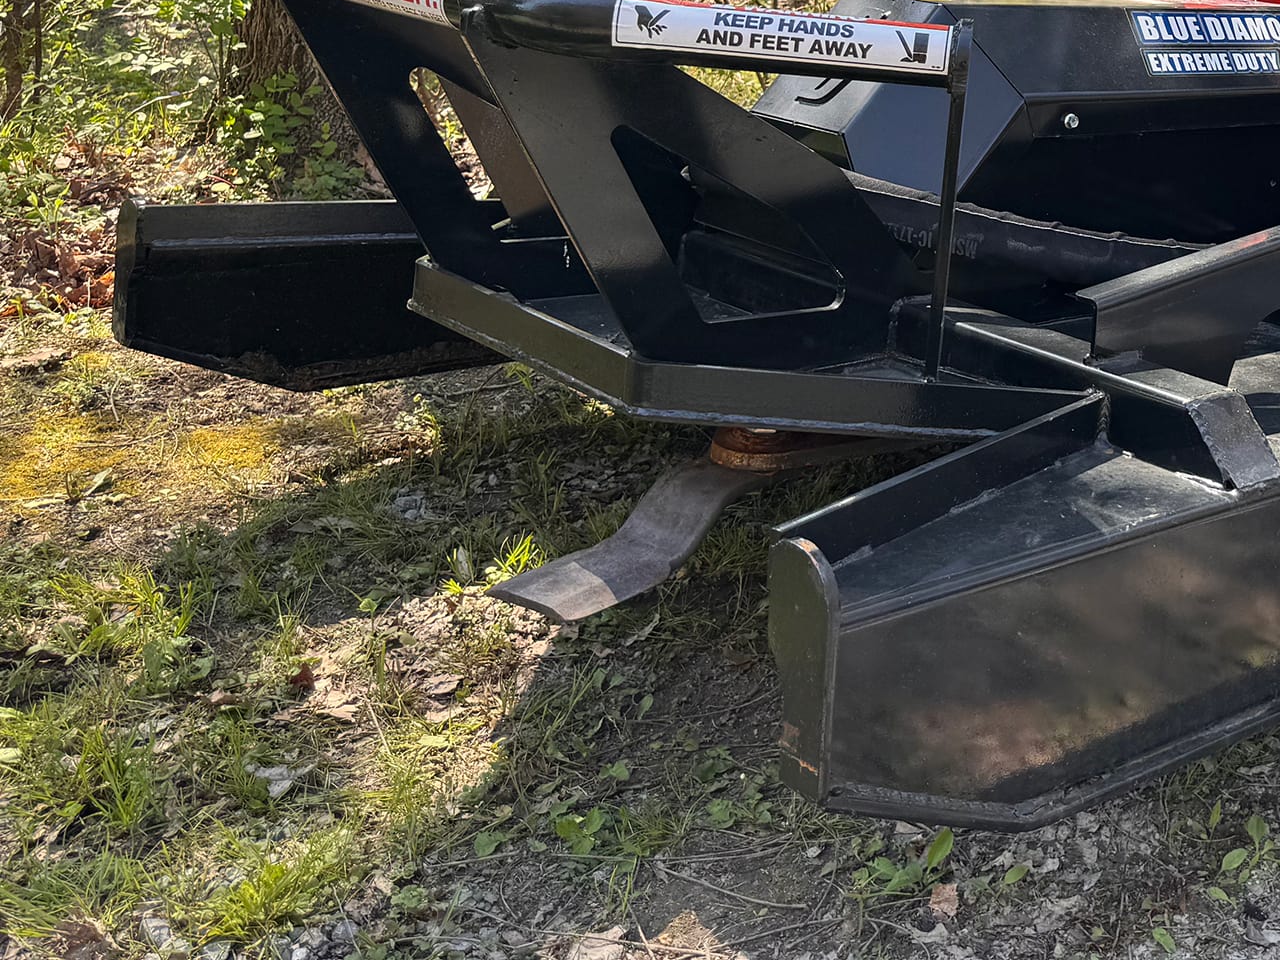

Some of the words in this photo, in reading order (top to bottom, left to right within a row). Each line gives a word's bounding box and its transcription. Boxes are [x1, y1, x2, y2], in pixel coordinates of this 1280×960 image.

[714, 12, 774, 31] KEEP
[777, 18, 854, 38] HANDS
[1137, 15, 1204, 41] BLUE
[696, 28, 747, 47] AND
[749, 33, 806, 53] FEET
[808, 38, 873, 59] AWAY
[1147, 52, 1233, 72] EXTREME
[1231, 52, 1280, 72] DUTY
